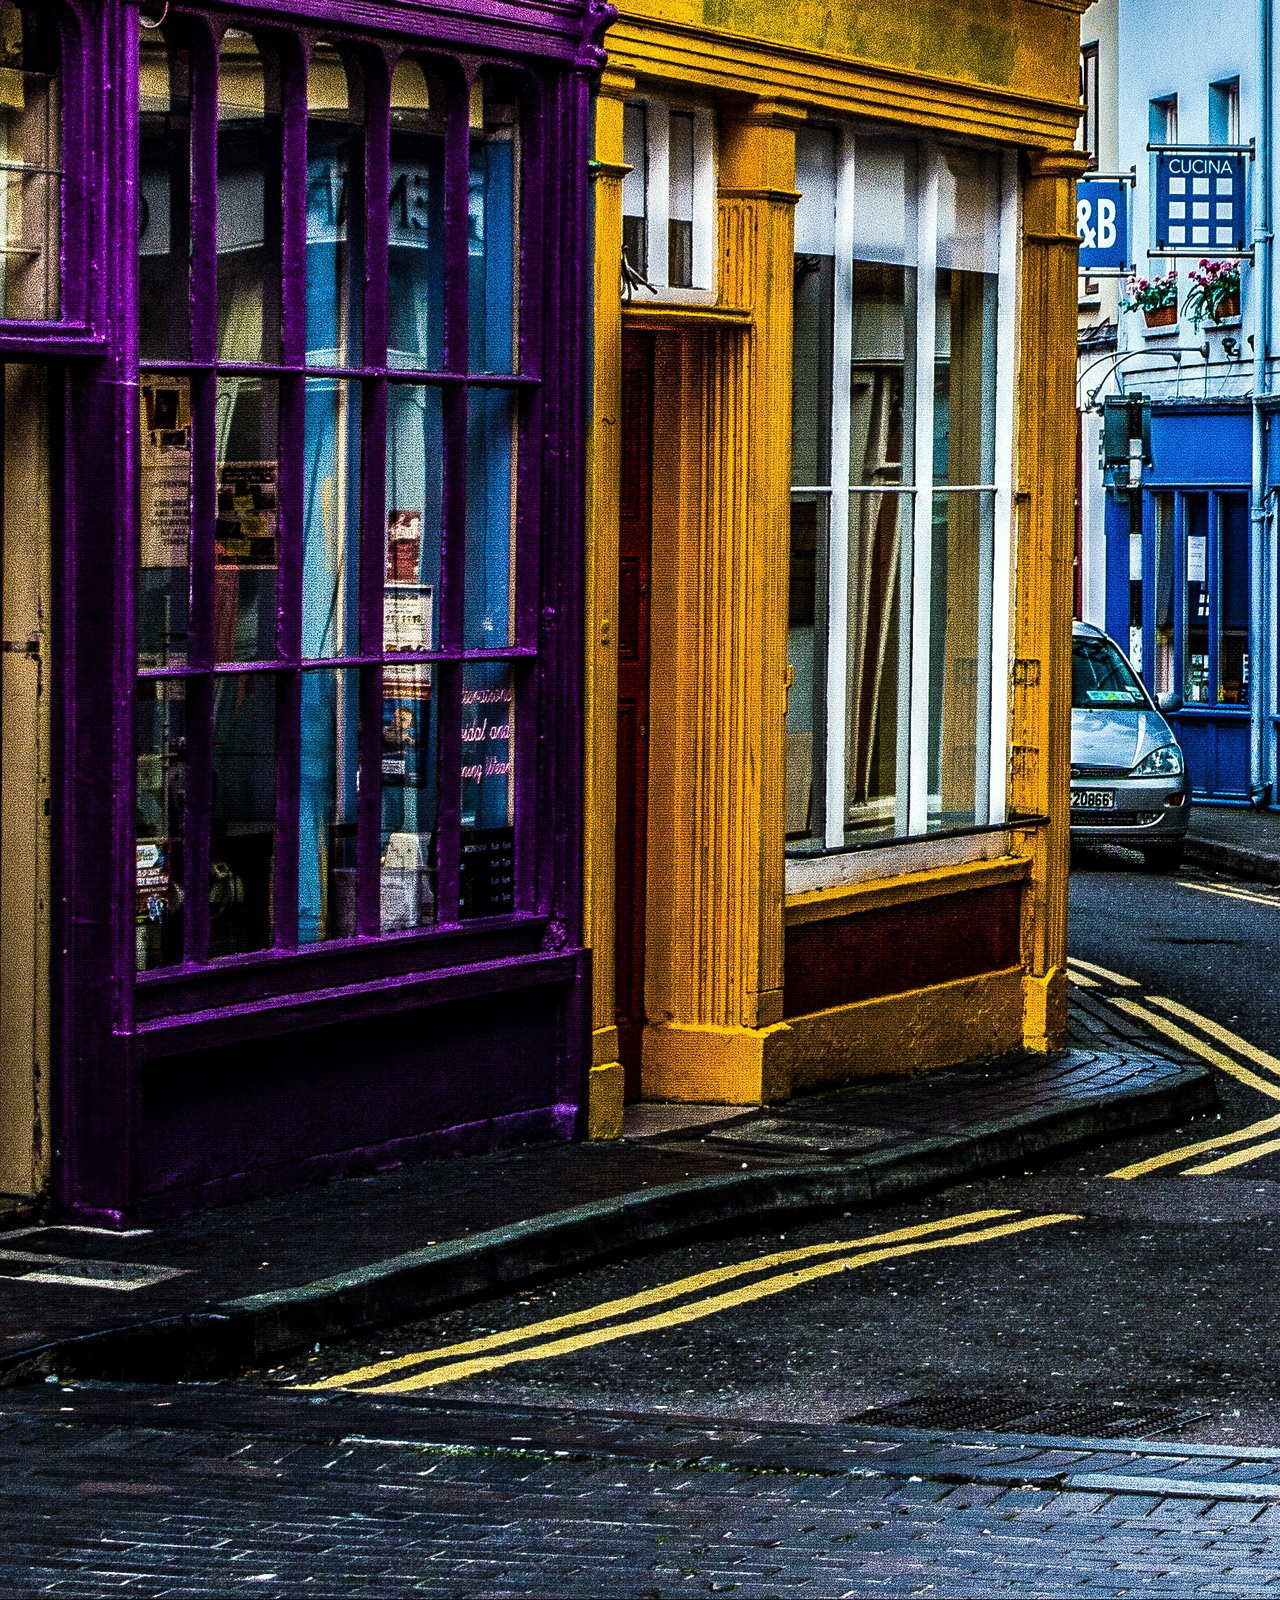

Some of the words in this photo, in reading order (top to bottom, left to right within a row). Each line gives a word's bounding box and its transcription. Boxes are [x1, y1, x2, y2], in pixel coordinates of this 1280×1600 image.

[1168, 158, 1233, 175] CUCINA
[1077, 198, 1117, 249] &B
[1070, 791, 1109, 807] 20866
